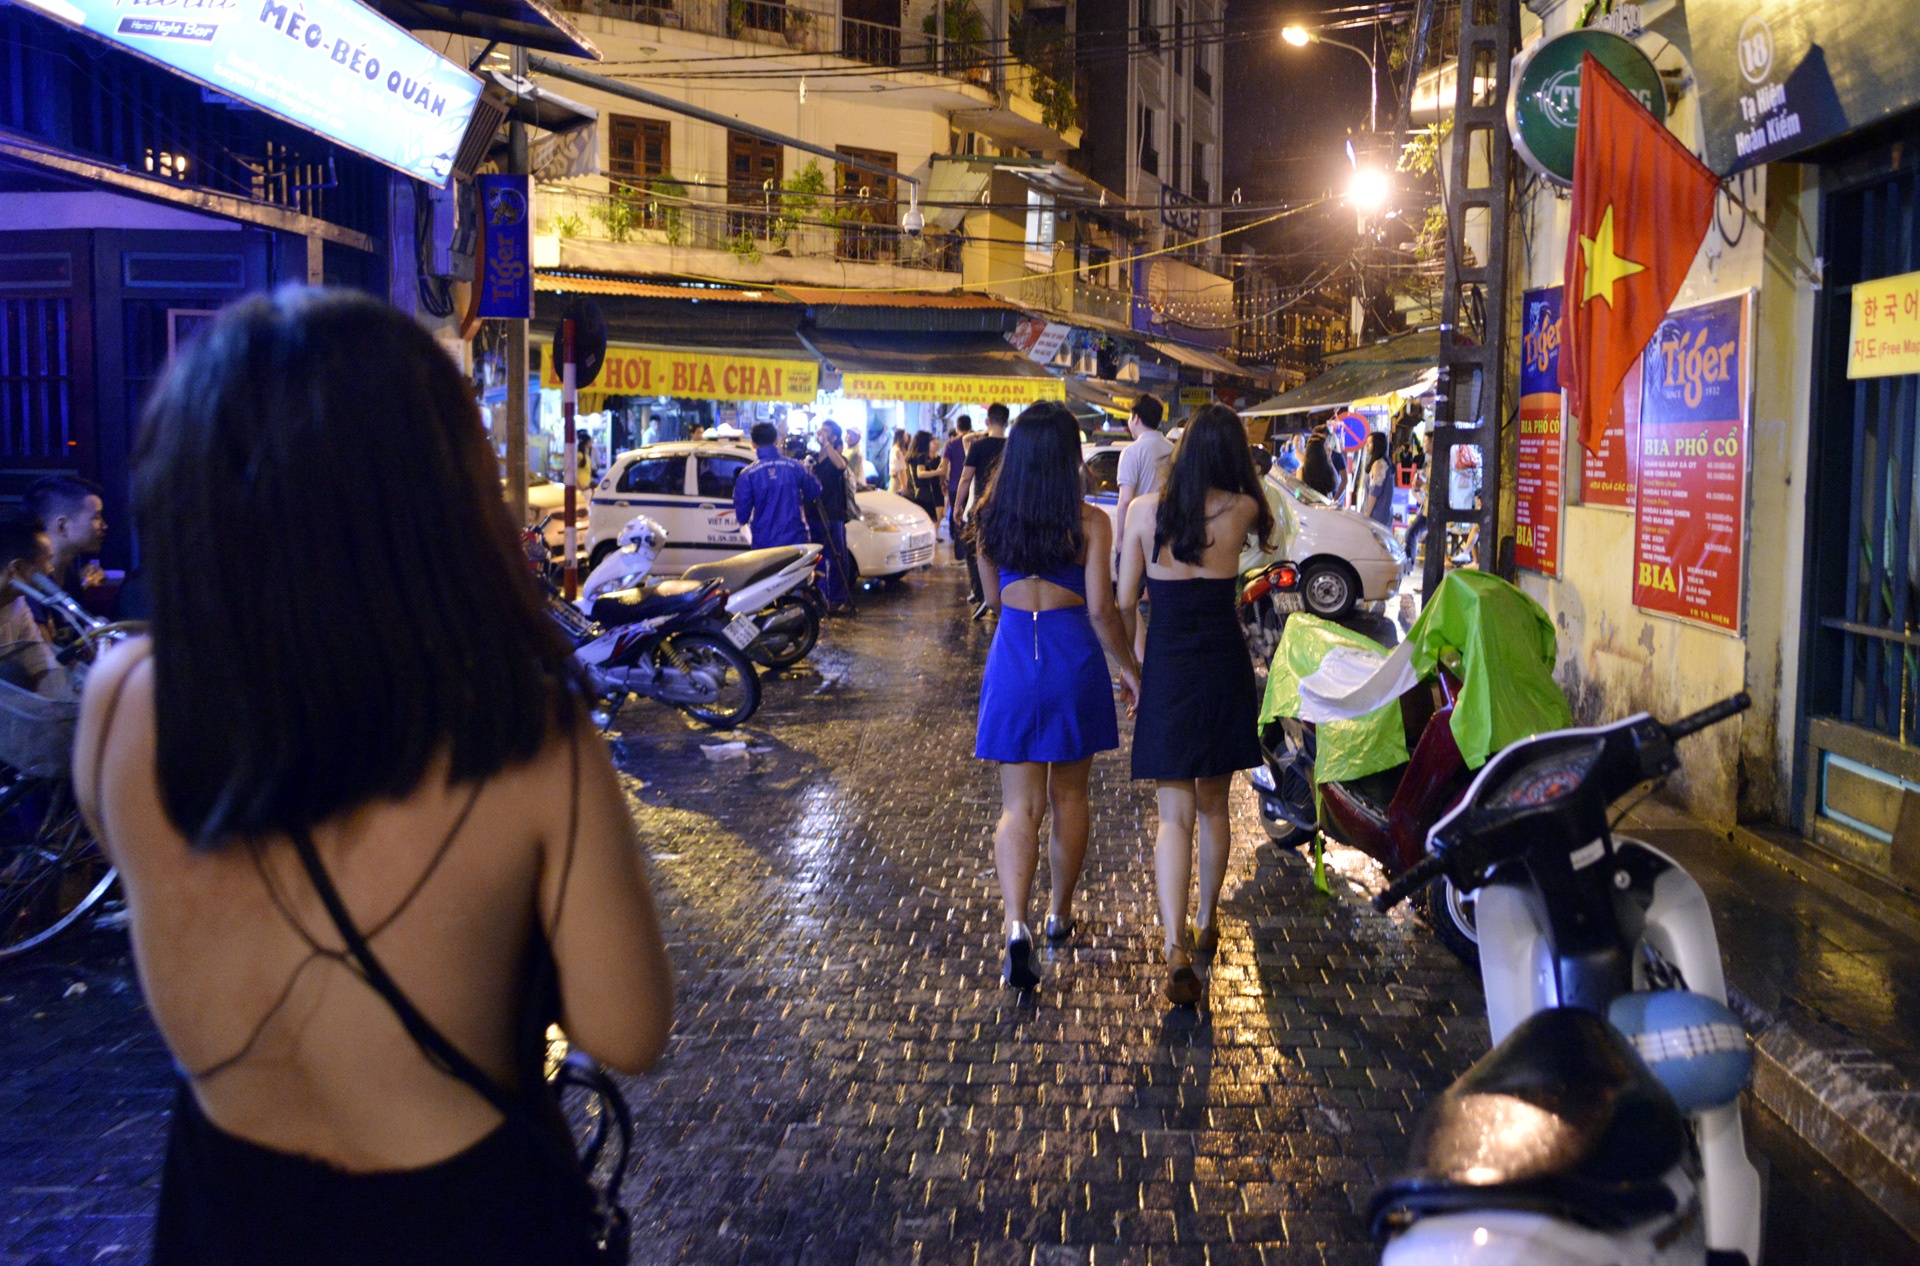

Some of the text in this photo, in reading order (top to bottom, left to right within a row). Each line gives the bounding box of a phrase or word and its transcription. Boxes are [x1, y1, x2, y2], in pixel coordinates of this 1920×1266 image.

[154, 21, 183, 36] Night
[183, 22, 214, 38] Bar
[1742, 33, 1768, 73] 18
[387, 70, 447, 118] QUÁN
[1740, 82, 1786, 123] Tạ Hiện
[490, 233, 525, 304] Tiger
[1864, 289, 1918, 327] 한국어
[671, 361, 716, 394] BIA
[723, 364, 783, 396] CHAI
[1661, 327, 1736, 409] Tiger
[853, 379, 887, 391] BIA
[979, 383, 1026, 395] LOAN
[1705, 386, 1721, 396] 1932
[1521, 419, 1533, 434] BIA
[1644, 425, 1739, 457] BIA PHỐ CỔ
[1516, 524, 1533, 548] BIA
[1639, 562, 1677, 593] BIA
